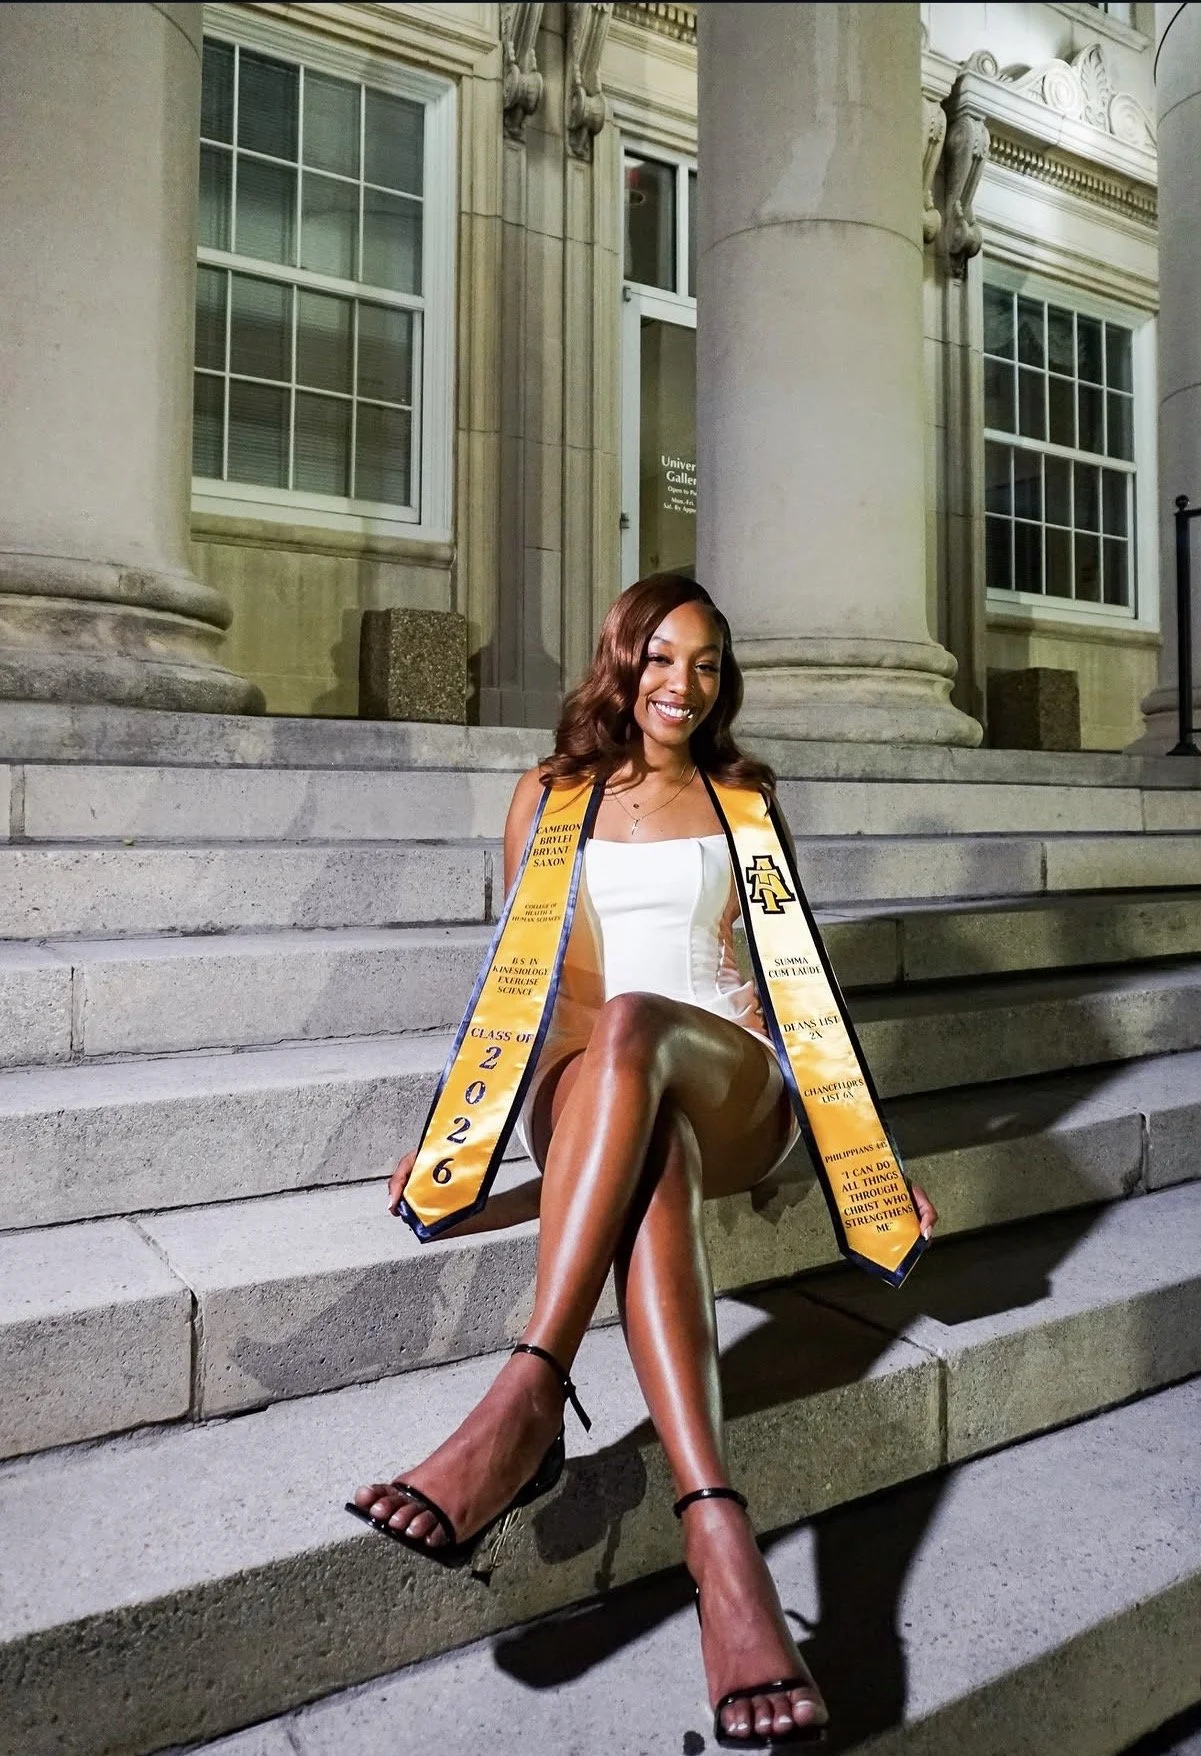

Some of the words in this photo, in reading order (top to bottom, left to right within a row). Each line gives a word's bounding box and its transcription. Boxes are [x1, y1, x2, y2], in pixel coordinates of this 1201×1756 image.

[661, 455, 697, 471] Univer
[666, 470, 697, 485] Galler
[667, 485, 683, 494] Open
[536, 823, 581, 834] CAMERON
[532, 845, 569, 857] BRYANT
[533, 857, 566, 868] SAXON
[529, 957, 539, 965] IN
[774, 957, 809, 966] SUMMA
[492, 966, 549, 976] KINESIOLOGY
[768, 968, 790, 978] CUM
[790, 965, 822, 976] LAUDE
[498, 976, 540, 986] EXERCISE
[497, 986, 533, 996] SCIENCE
[819, 1015, 839, 1027] LIST
[471, 1027, 512, 1042] CLASS
[516, 1034, 535, 1043] OF
[808, 1030, 823, 1040] 2X
[821, 1094, 841, 1103] LIST
[842, 1091, 854, 1099] 6X
[825, 1144, 874, 1163] PHILIPPIANS
[852, 1164, 874, 1177] CAN
[876, 1160, 890, 1170] DO
[842, 1181, 860, 1193] ALL
[862, 1170, 899, 1187] THINGS
[849, 1183, 899, 1203] THROUGH
[843, 1200, 880, 1216] CHRIST
[883, 1193, 908, 1206] WHO
[845, 1203, 914, 1229] STRENGTHENS
